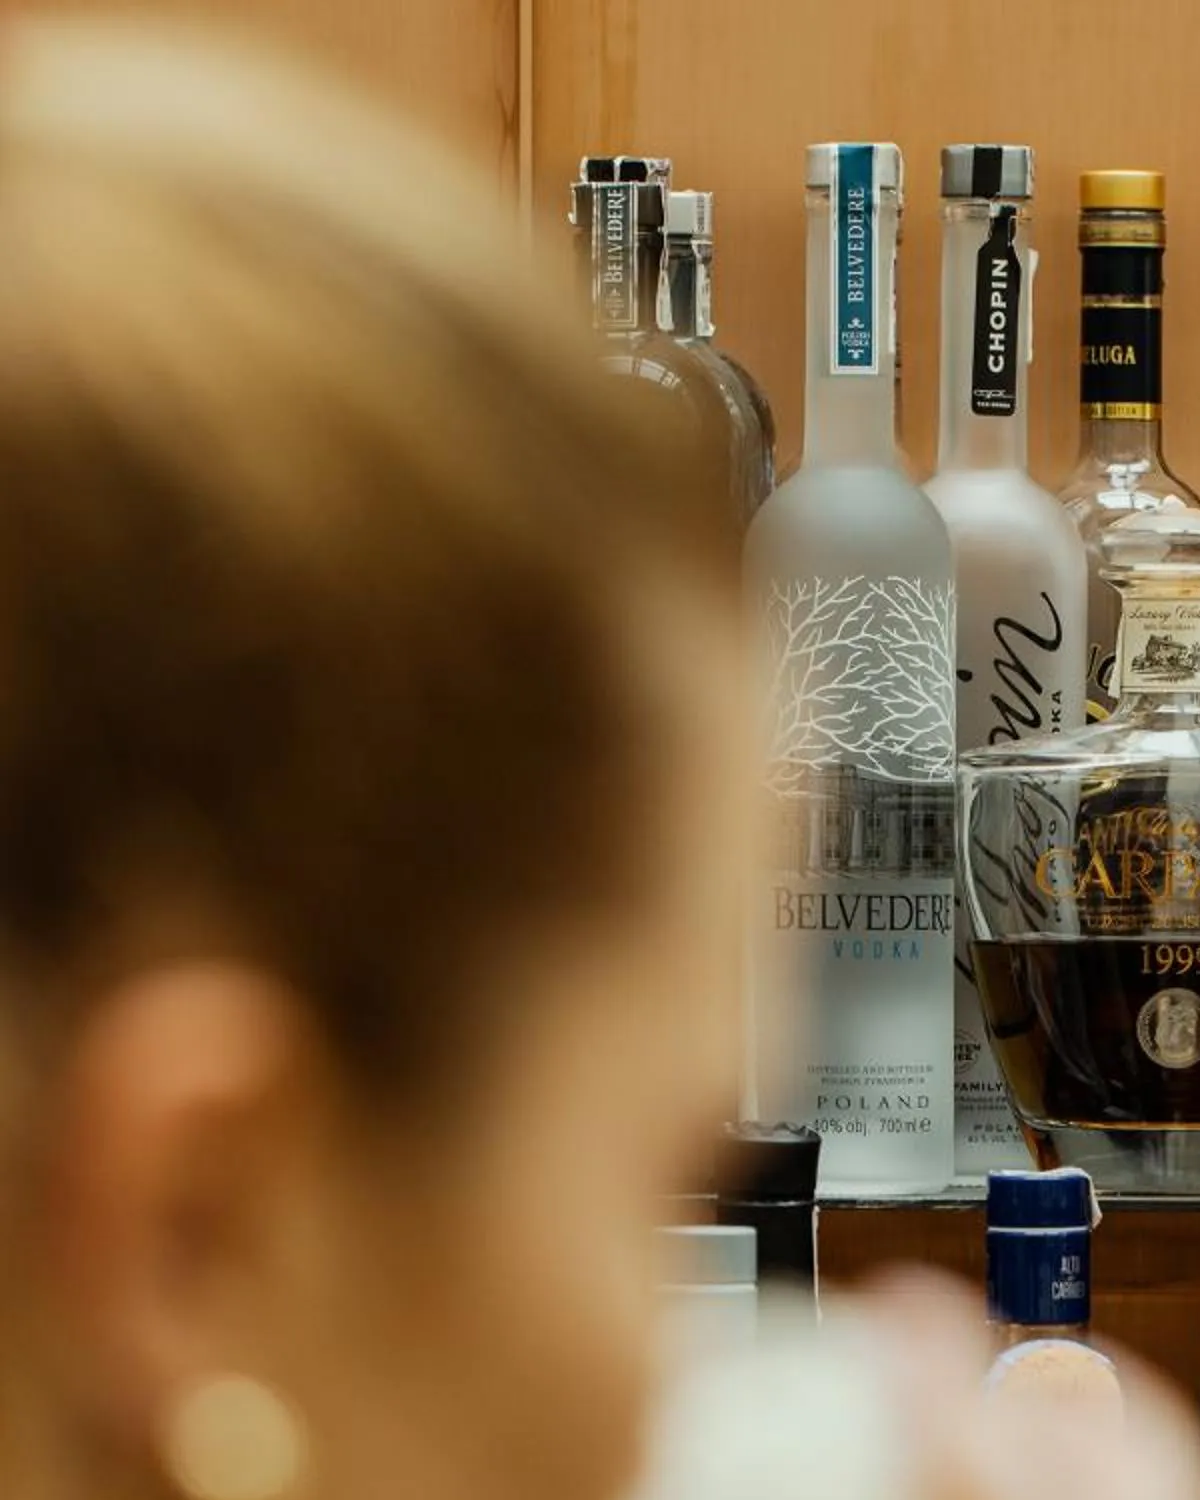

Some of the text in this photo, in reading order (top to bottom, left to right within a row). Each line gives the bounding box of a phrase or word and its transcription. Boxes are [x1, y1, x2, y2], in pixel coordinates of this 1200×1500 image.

[847, 187, 865, 303] BELVEDERE
[987, 258, 1009, 373] CHOPIN
[832, 939, 922, 959] VODKA
[816, 1095, 930, 1110] POLAND
